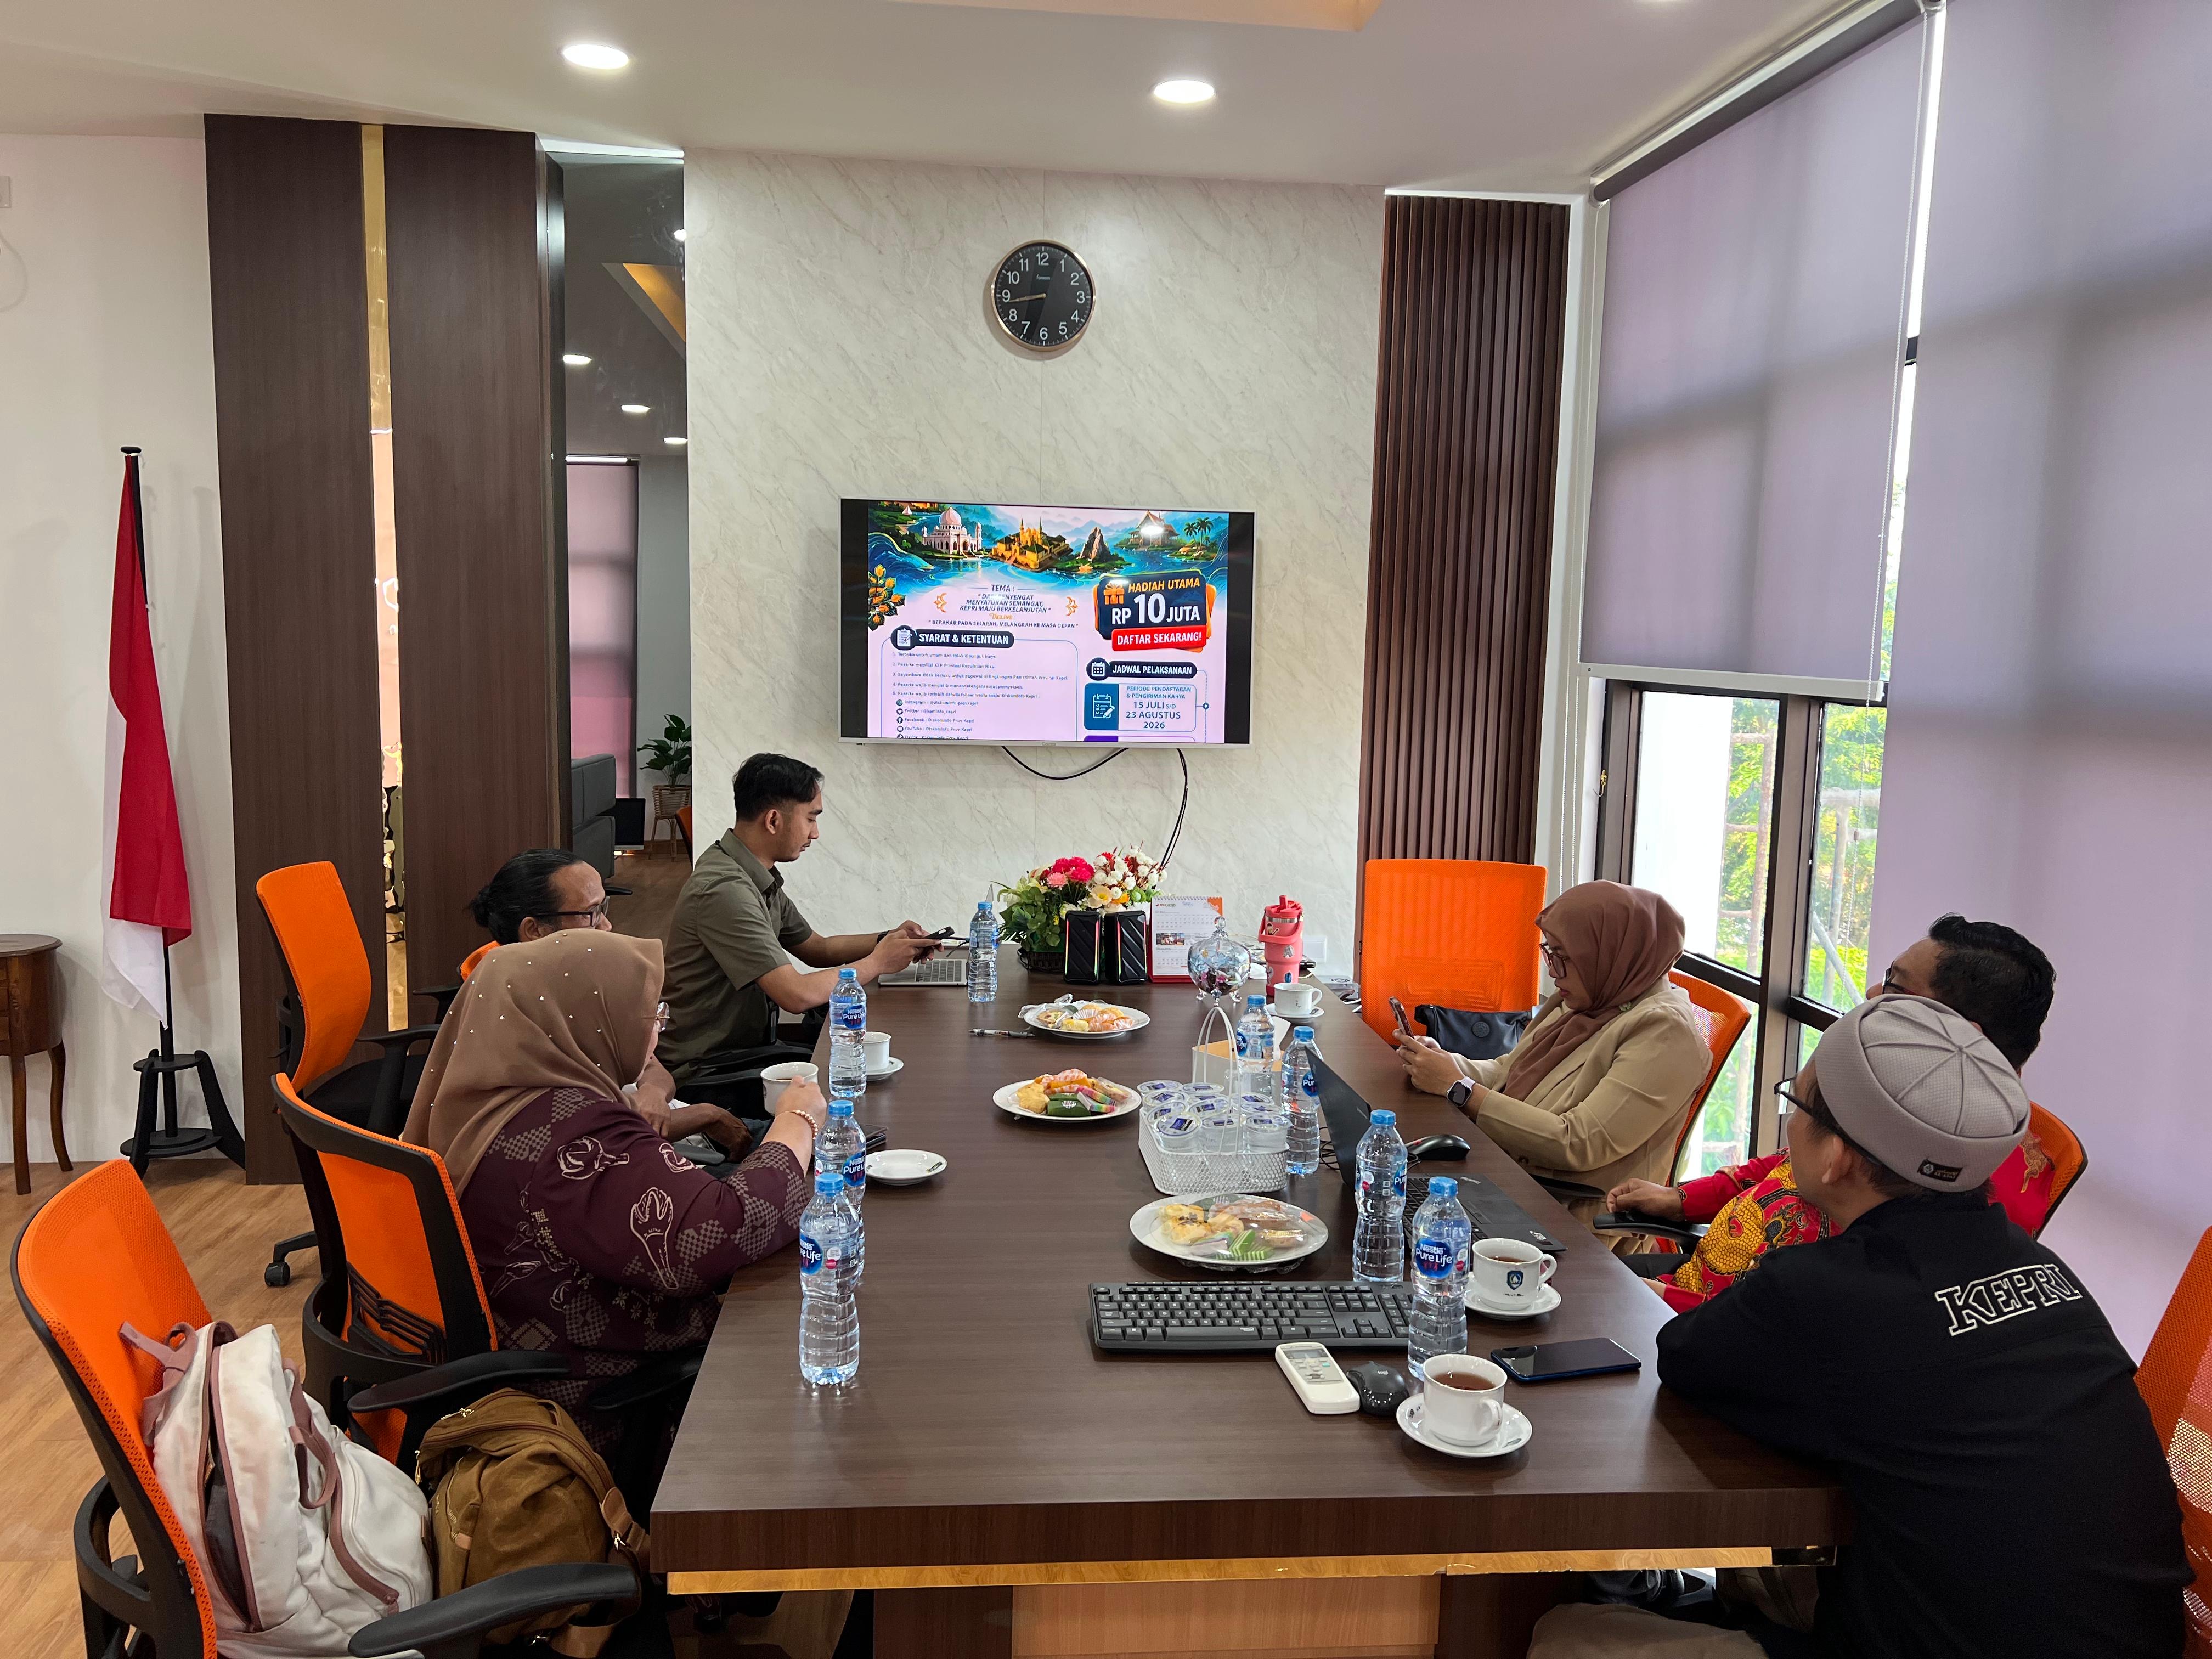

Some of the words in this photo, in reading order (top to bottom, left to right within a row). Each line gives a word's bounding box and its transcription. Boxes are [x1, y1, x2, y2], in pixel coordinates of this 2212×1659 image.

[1019, 258, 1029, 272] 11
[1036, 252, 1049, 266] 12
[1060, 259, 1064, 272] 1
[1006, 271, 1020, 284] 10
[1070, 272, 1079, 285] 2
[1002, 290, 1011, 302] 9
[1076, 291, 1085, 304] 3
[1009, 309, 1018, 321] 8
[1071, 309, 1080, 323] 4
[1022, 321, 1030, 334] 7
[1039, 327, 1048, 340] 6
[1059, 322, 1067, 335] 5
[1128, 580, 1165, 593] HADIAH
[1167, 578, 1200, 590] UTAMA
[1111, 607, 1131, 624] RP
[1133, 593, 1166, 623] 10
[1166, 606, 1200, 622] JUTA
[919, 633, 950, 643] SYARAT
[952, 634, 959, 643] &
[961, 634, 1008, 644] KETENTUAN
[1117, 634, 1151, 645] DAFTAR
[1153, 631, 1201, 644] SEKARANG!
[1113, 665, 1141, 674] JADWAL
[1143, 665, 1192, 675] PELAKSANAAN
[843, 1165, 861, 1174] Pure
[806, 1250, 821, 1263] Life
[1416, 1248, 1435, 1262] Pure
[1436, 1254, 1452, 1267] Life
[1934, 1263, 2083, 1336] KEPRI
